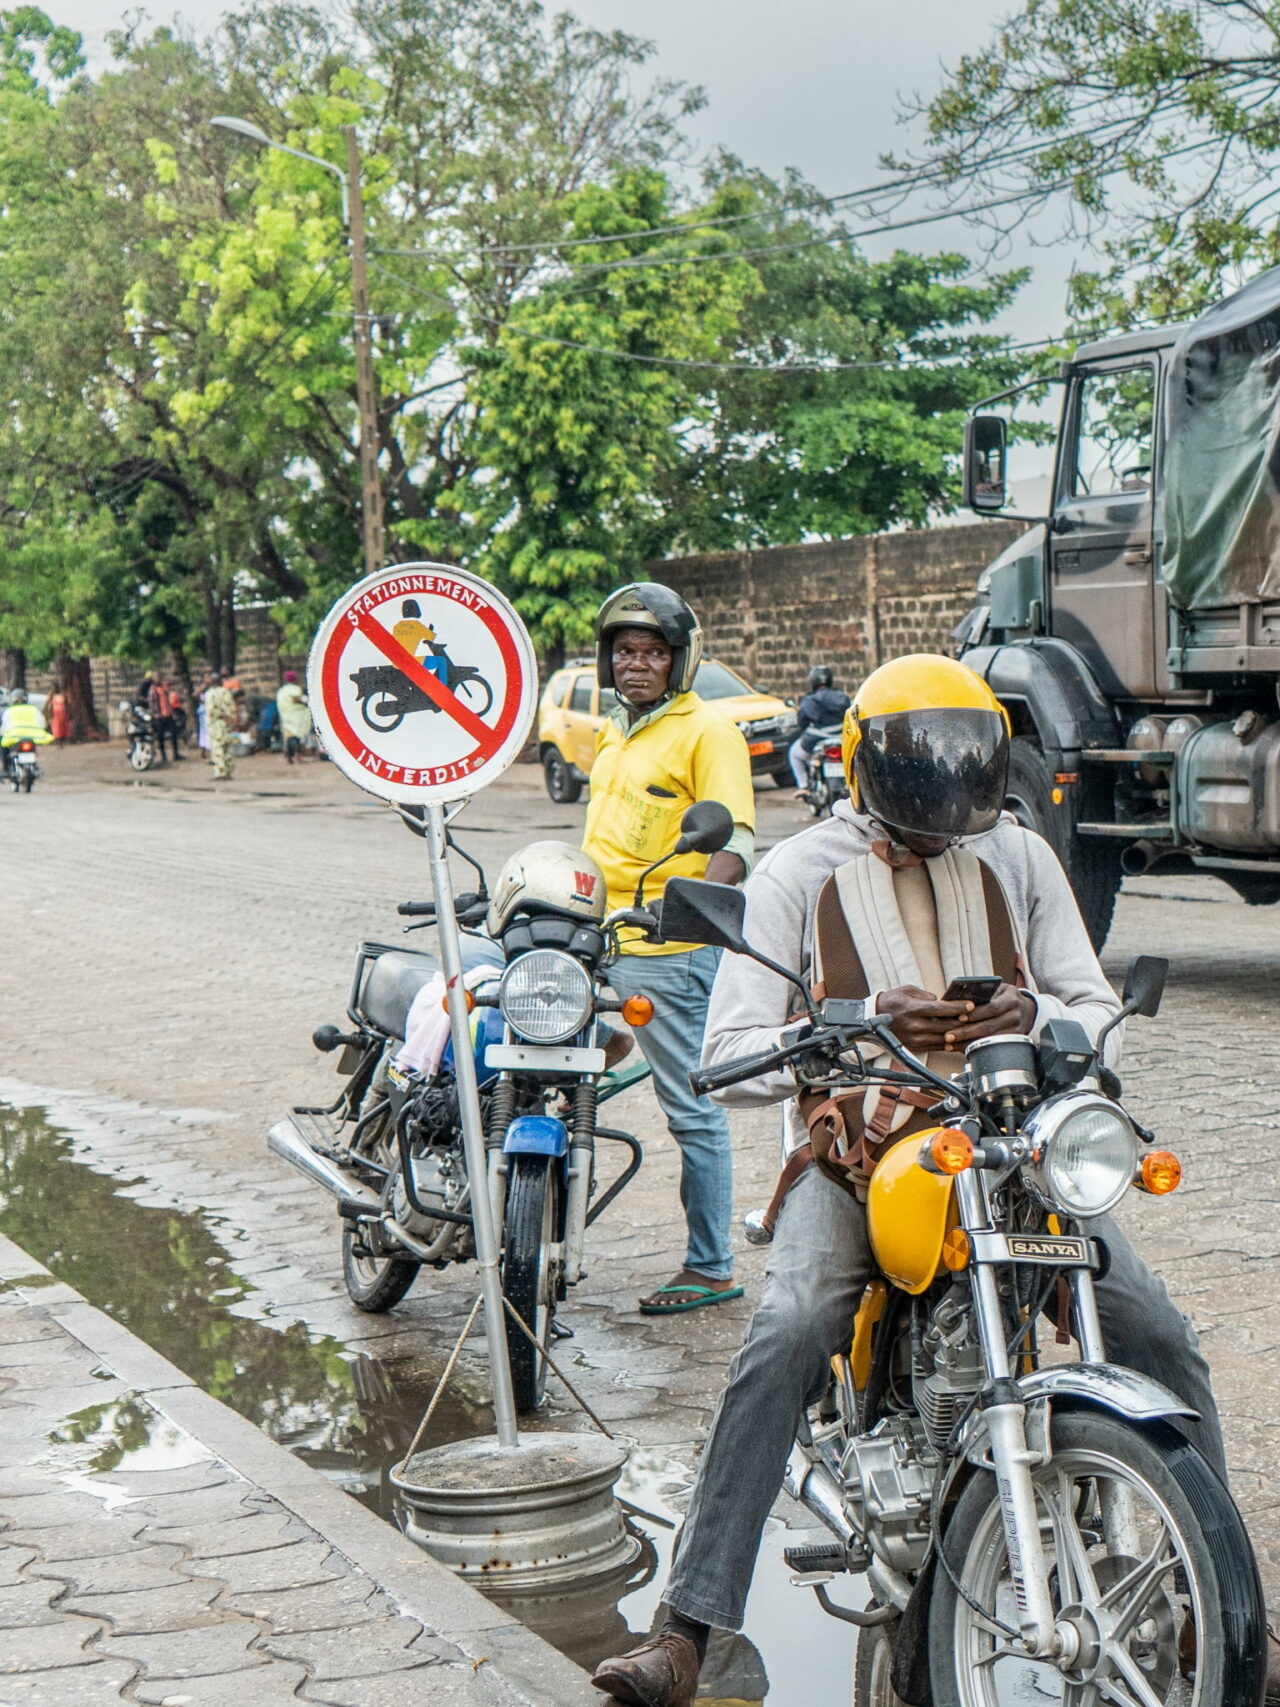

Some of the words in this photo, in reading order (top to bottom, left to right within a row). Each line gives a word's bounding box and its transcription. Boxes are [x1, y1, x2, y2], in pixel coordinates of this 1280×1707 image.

[347, 577, 488, 627] STATIONNEMENT
[356, 749, 470, 785] INTERDIT
[1014, 1242, 1078, 1256] SANYA
